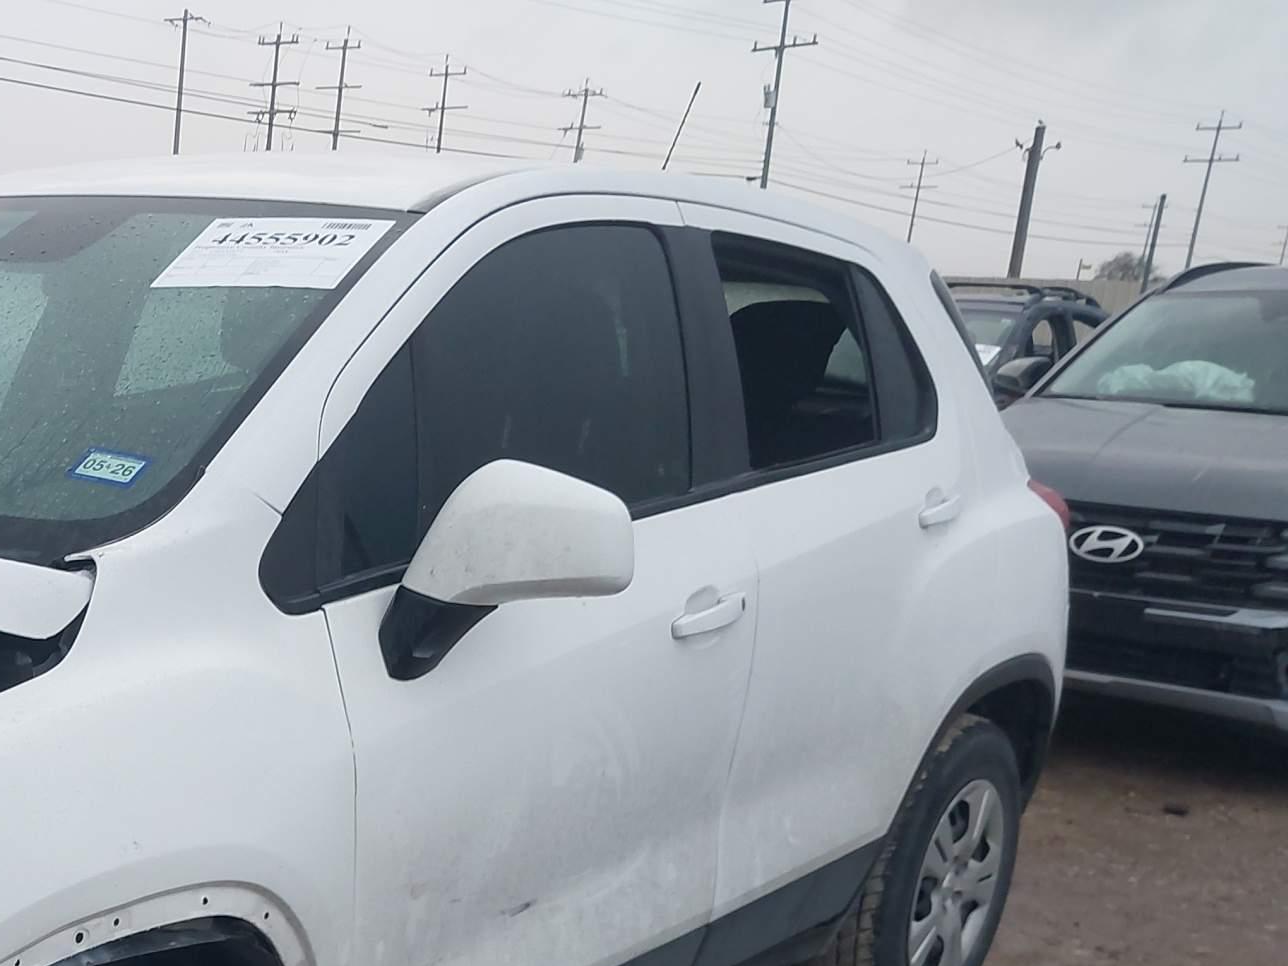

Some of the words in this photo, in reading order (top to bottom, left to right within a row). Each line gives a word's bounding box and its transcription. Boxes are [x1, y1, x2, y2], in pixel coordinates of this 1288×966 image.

[211, 232, 356, 247] 44555902
[82, 458, 107, 471] 05
[109, 463, 136, 477] 26
